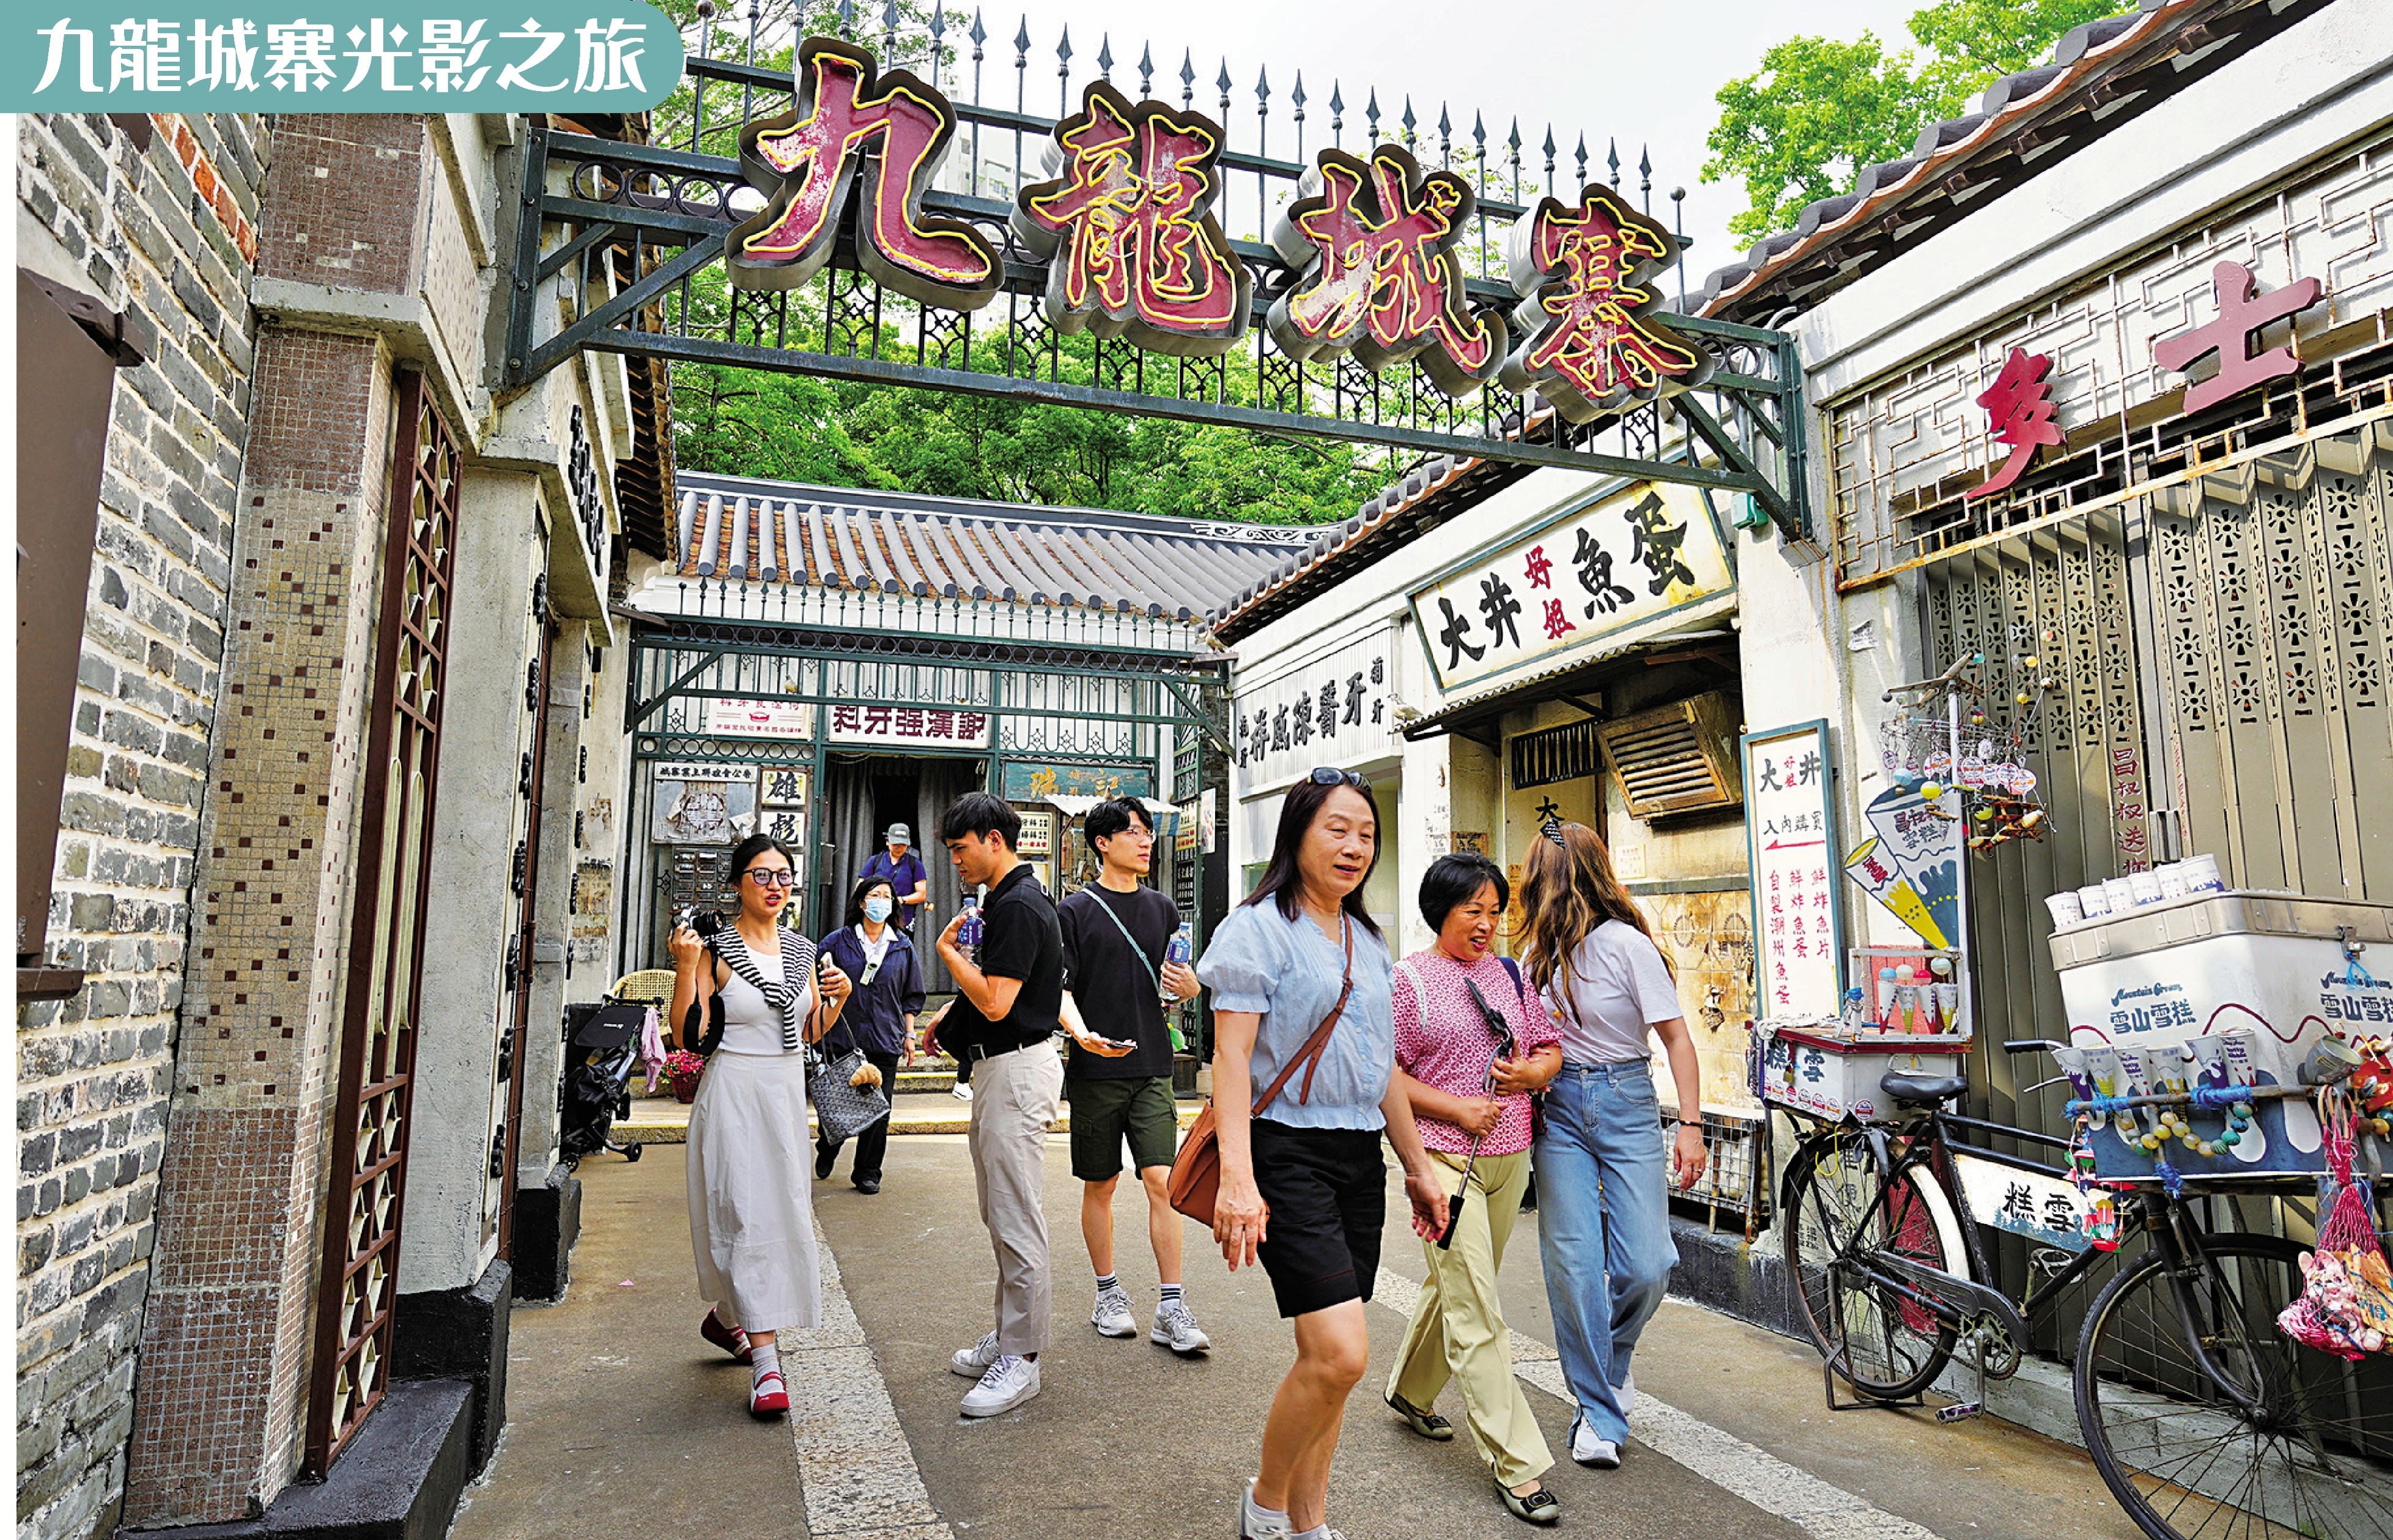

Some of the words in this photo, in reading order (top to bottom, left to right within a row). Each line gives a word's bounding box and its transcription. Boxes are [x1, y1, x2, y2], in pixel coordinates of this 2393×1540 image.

[731, 43, 1706, 407] 九龍城寨
[1535, 795, 1565, 822] 大
[1769, 869, 1790, 1004] 自製潮州魚蛋
[1788, 868, 1808, 959] 鮮炸魚蛋
[1810, 866, 1829, 960] 鮮炸魚片
[2109, 998, 2197, 1034] 雪山雪糕
